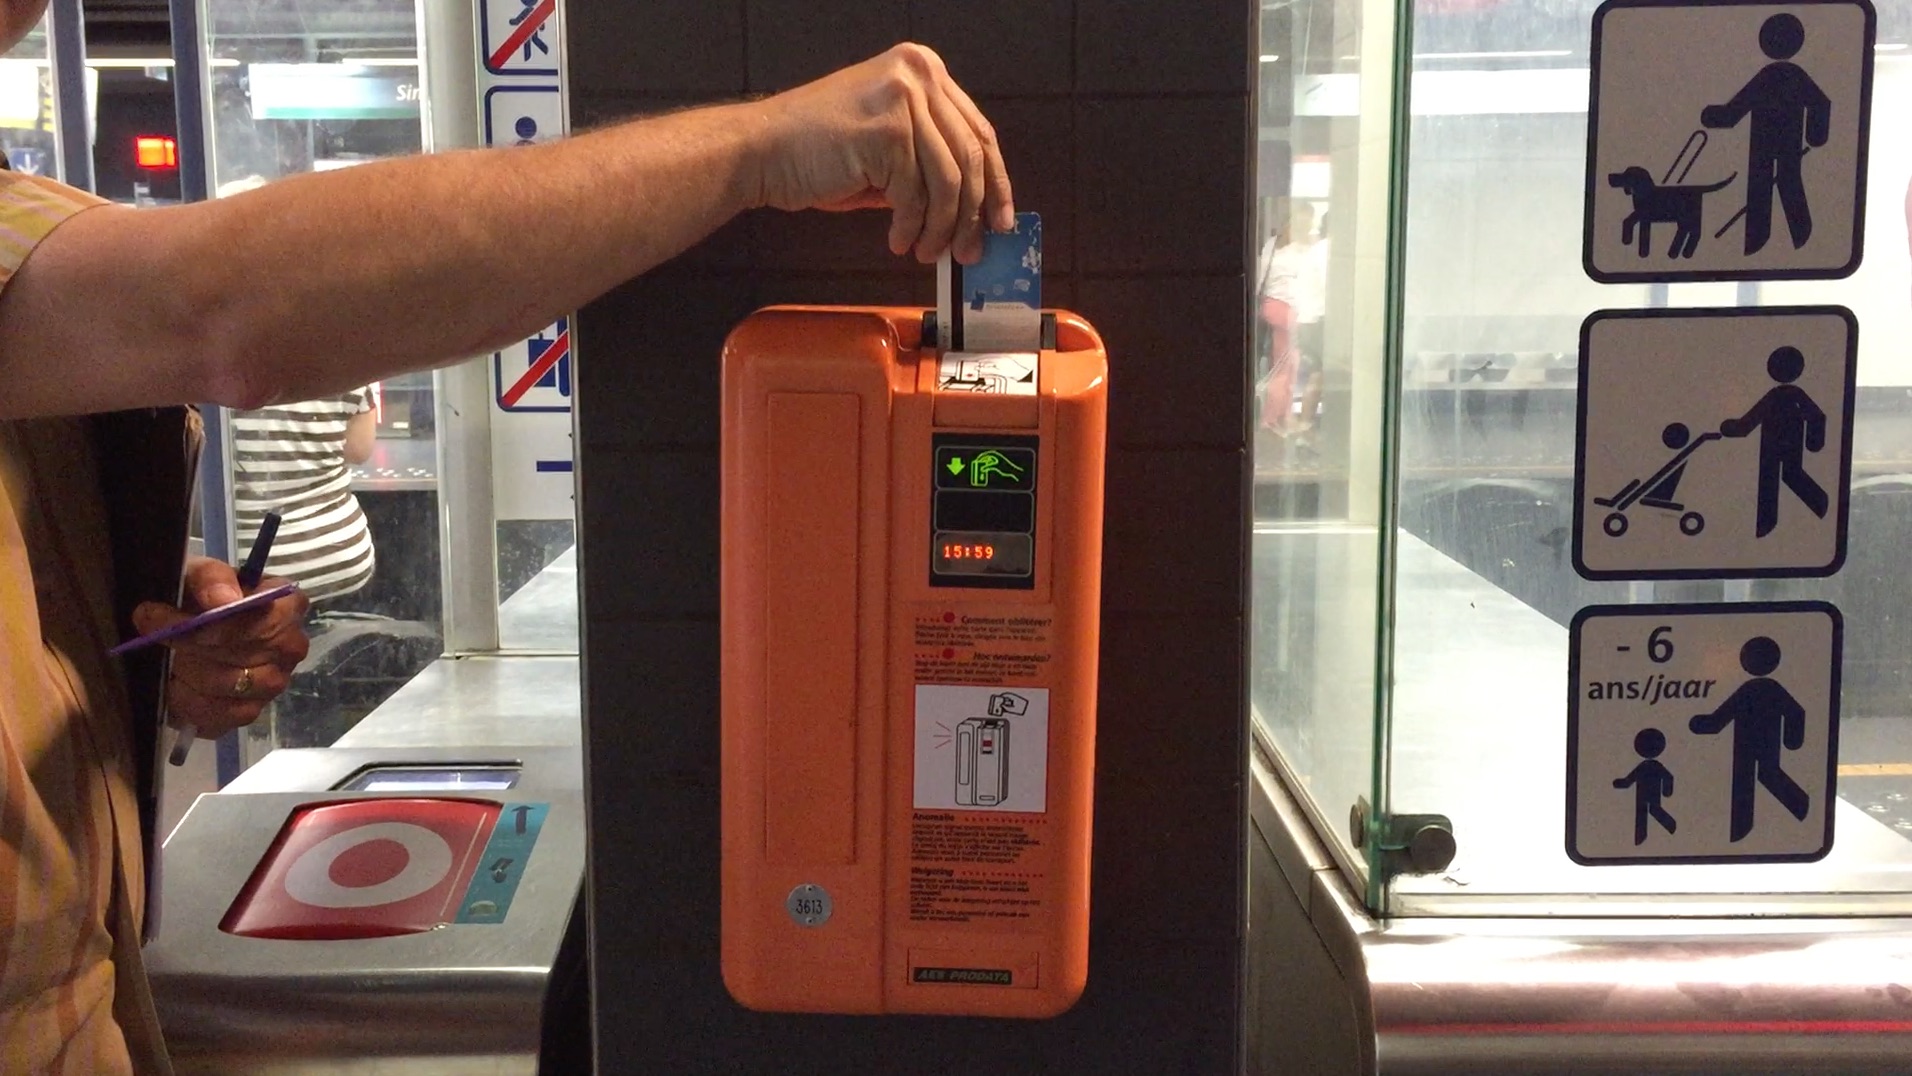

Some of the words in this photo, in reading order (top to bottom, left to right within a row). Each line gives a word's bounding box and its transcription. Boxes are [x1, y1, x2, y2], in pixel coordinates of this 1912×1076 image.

[944, 545, 993, 559] 15:59
[1648, 626, 1674, 663] 6
[1588, 674, 1716, 706] ans/jaar
[796, 899, 823, 914] 3613
